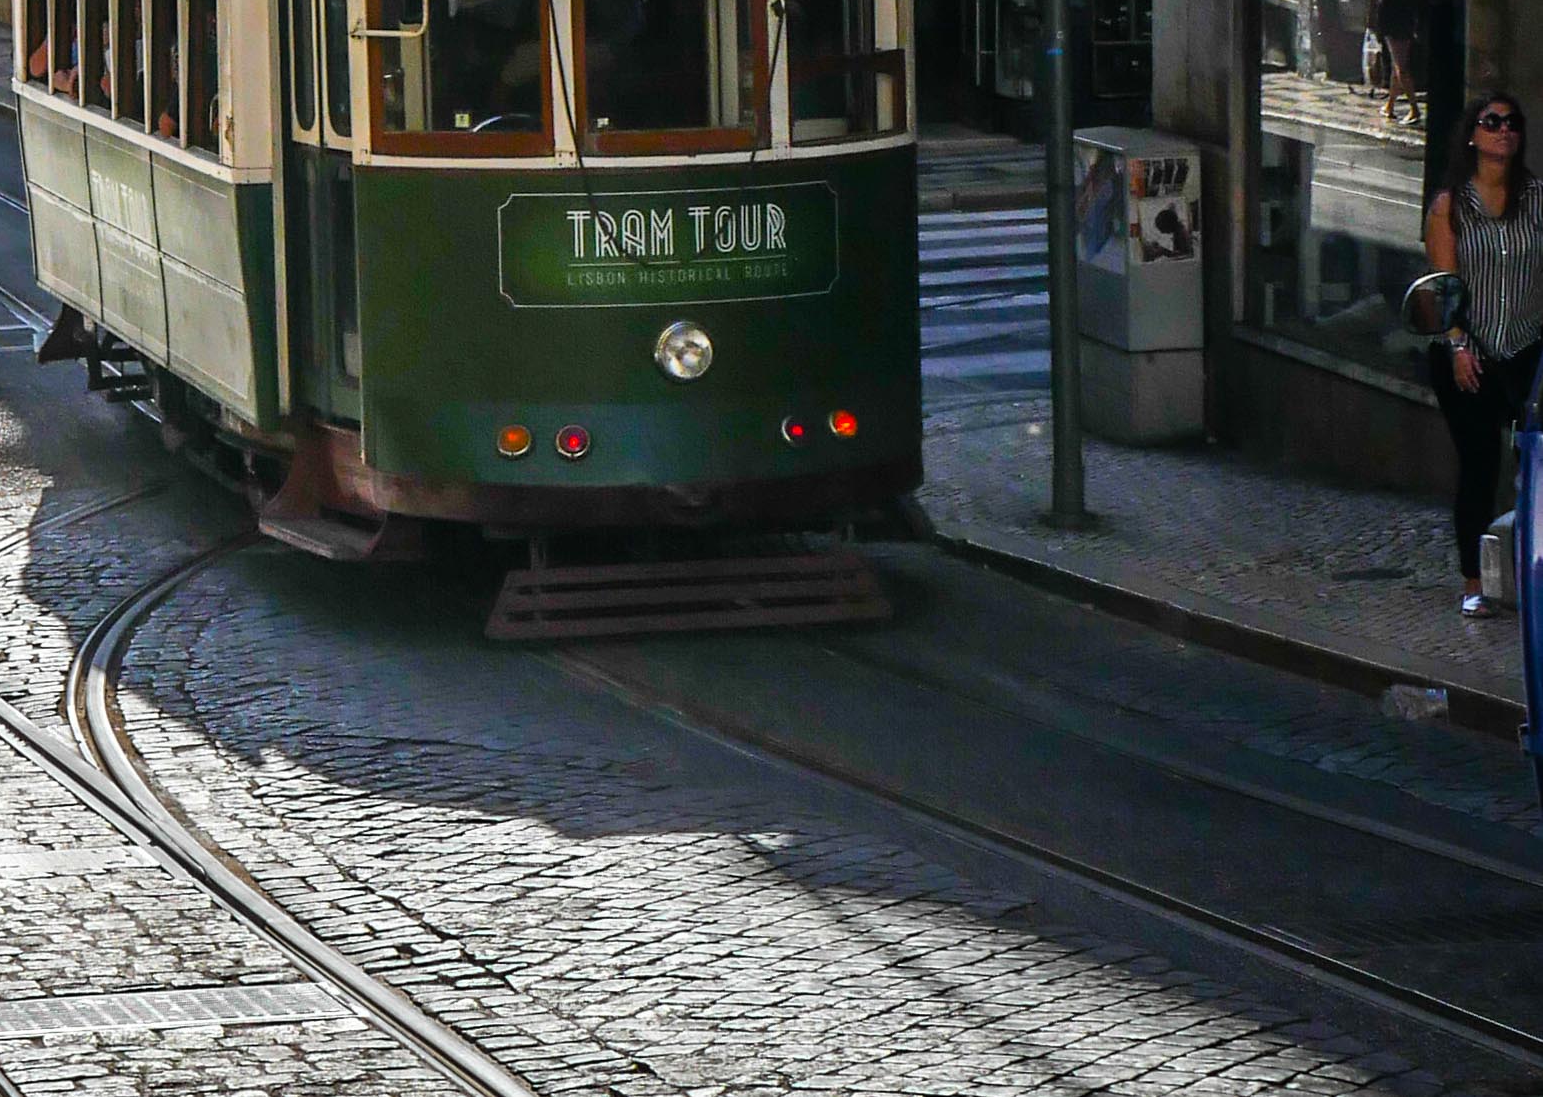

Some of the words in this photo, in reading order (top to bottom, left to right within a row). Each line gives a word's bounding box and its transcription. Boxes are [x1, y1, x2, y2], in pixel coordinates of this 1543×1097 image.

[566, 208, 674, 259] TRAM
[687, 202, 787, 254] TOUR
[567, 270, 627, 286] LISBON
[638, 266, 731, 285] HISTORICAL
[745, 262, 789, 280] ROUTE
